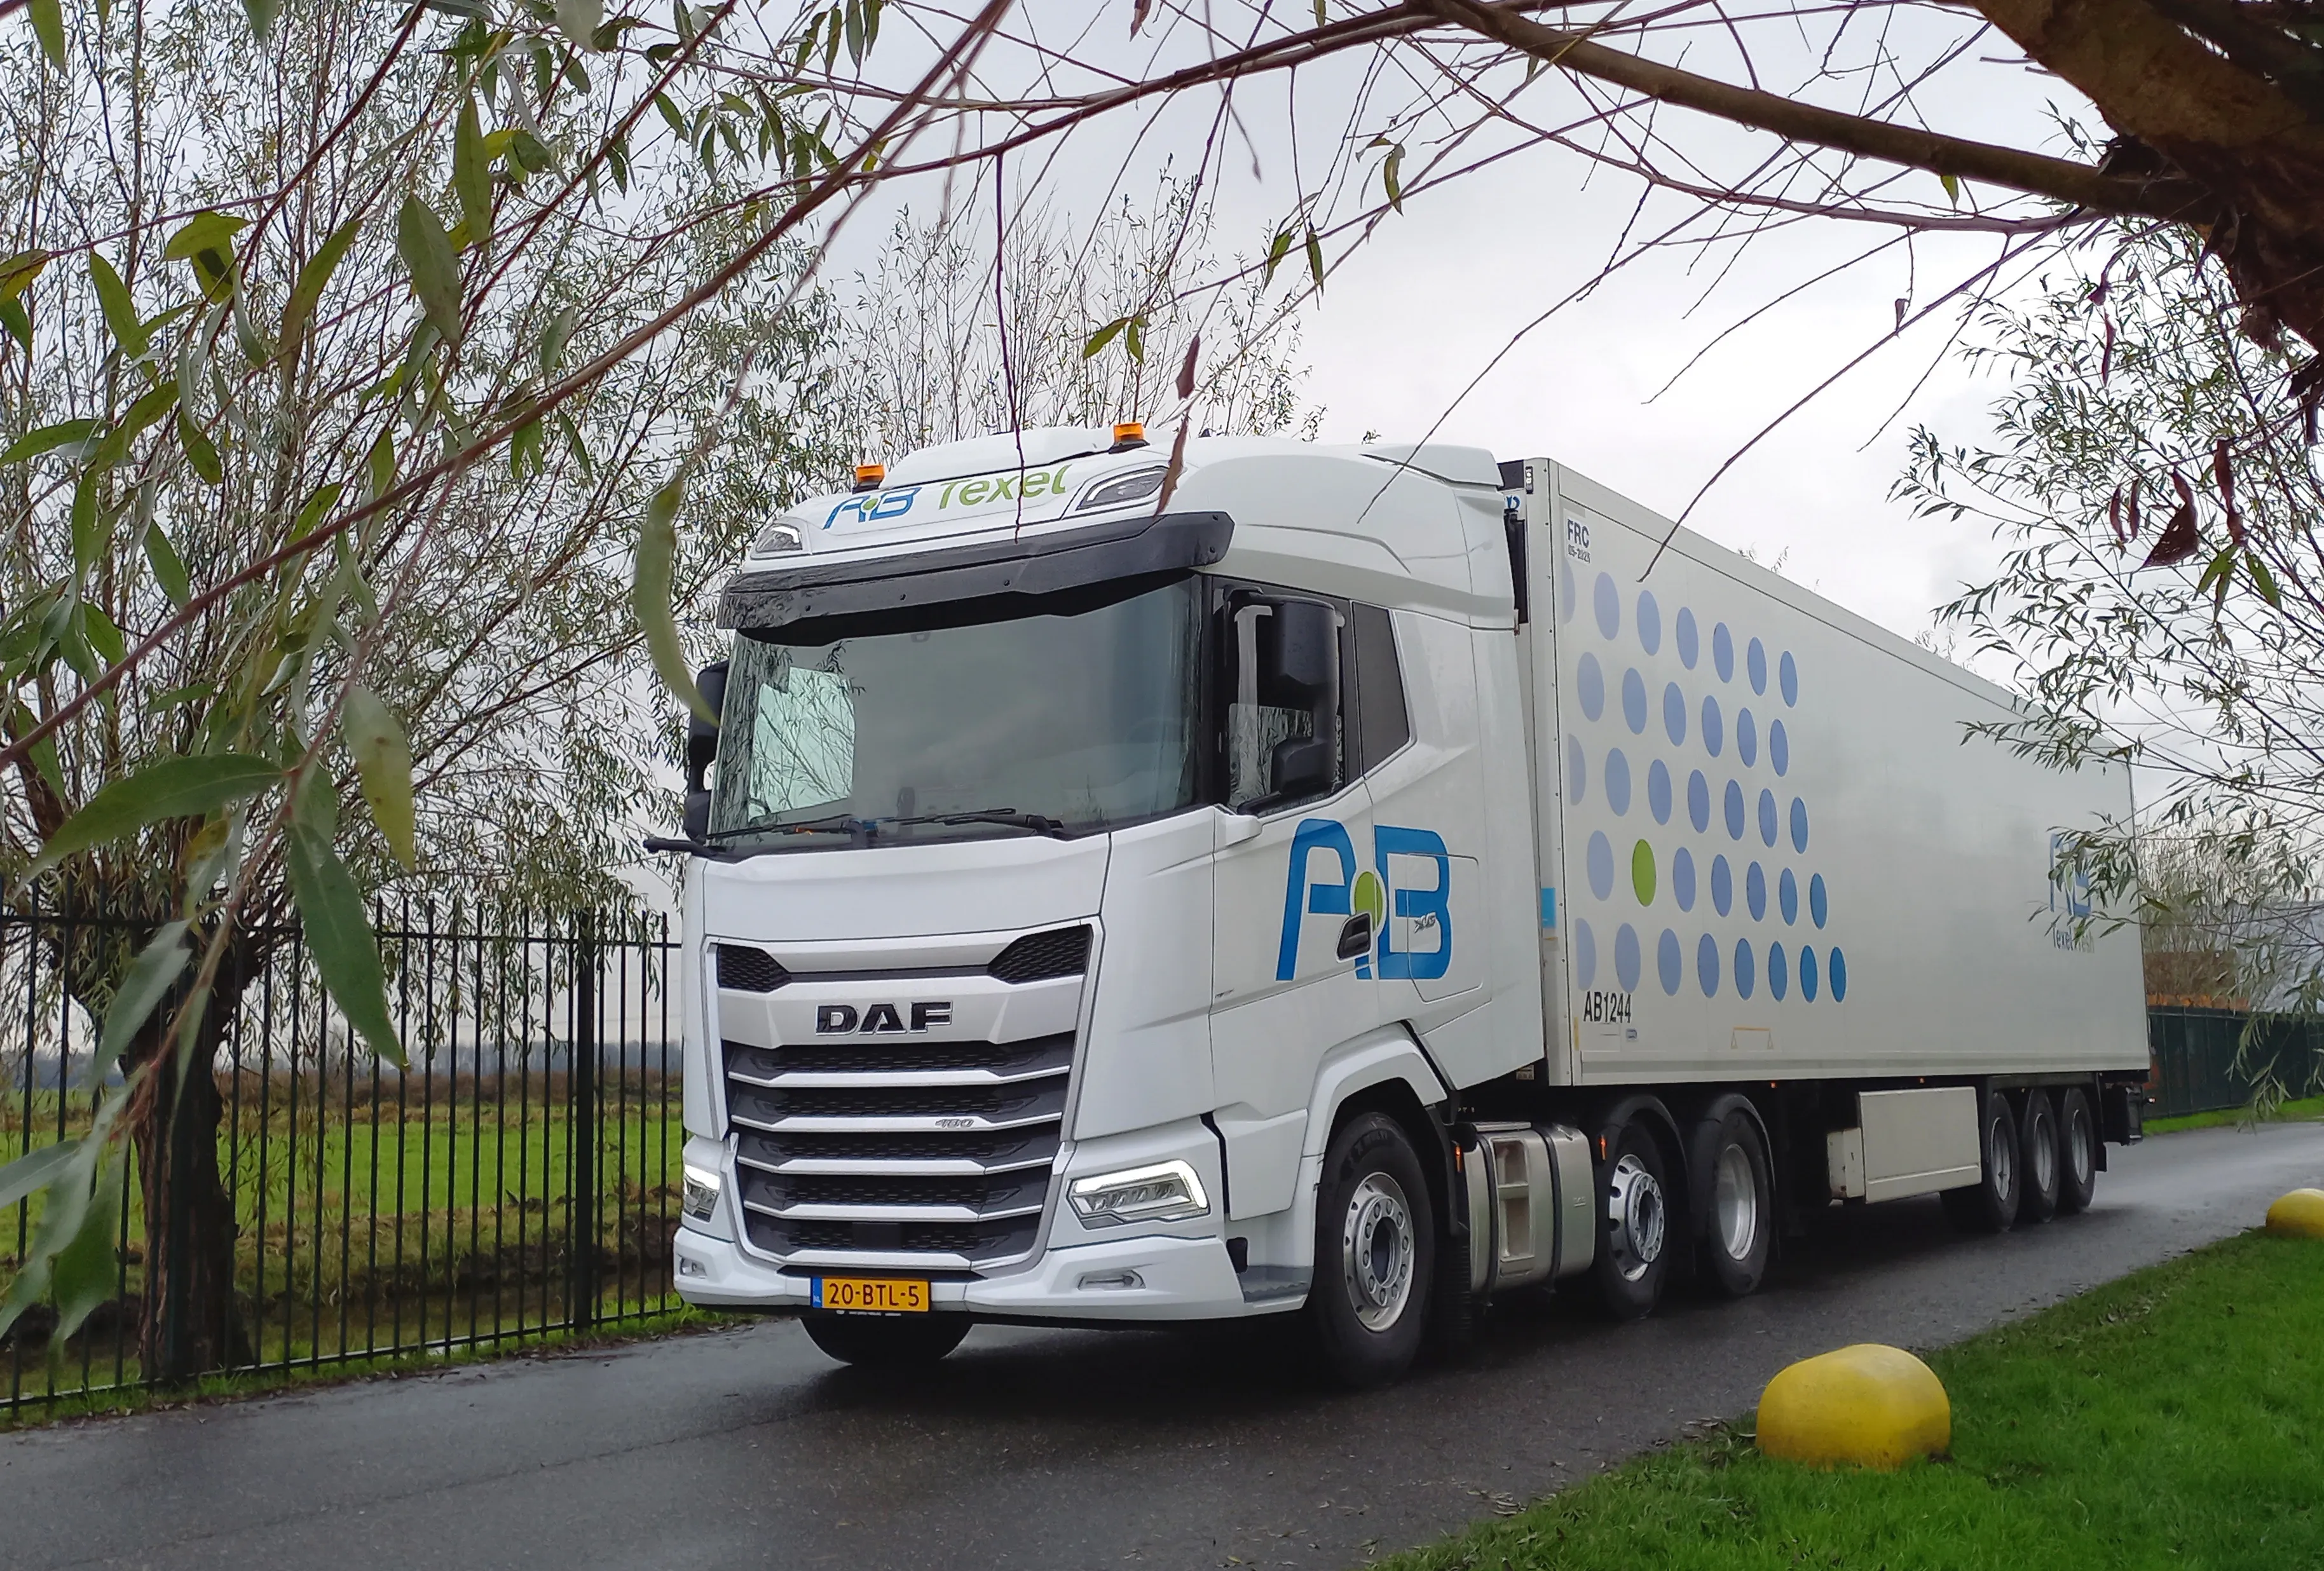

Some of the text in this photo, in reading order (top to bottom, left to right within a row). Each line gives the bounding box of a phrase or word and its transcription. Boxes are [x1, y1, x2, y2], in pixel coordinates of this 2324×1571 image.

[823, 465, 1072, 530] AB Texel
[1567, 519, 1590, 548] FRC
[1275, 818, 1451, 981] AB
[816, 1001, 953, 1037] DAF
[1583, 990, 1632, 1023] AB1244
[828, 1282, 920, 1307] 20-BTL-5
